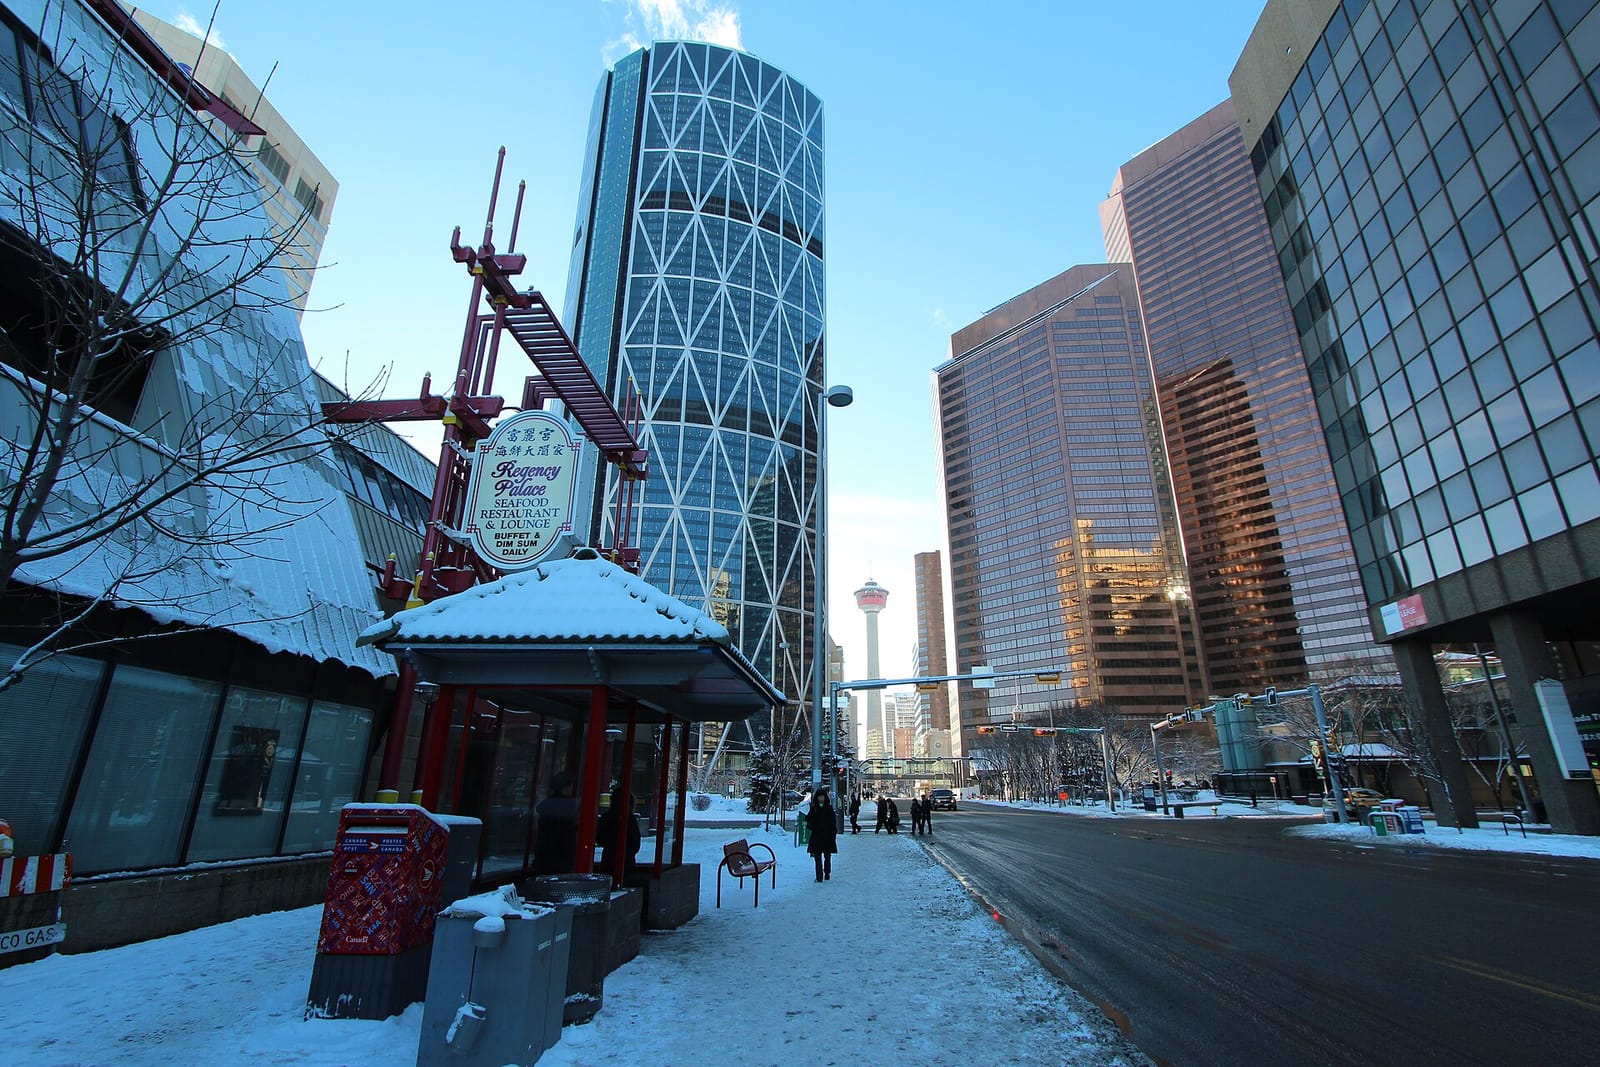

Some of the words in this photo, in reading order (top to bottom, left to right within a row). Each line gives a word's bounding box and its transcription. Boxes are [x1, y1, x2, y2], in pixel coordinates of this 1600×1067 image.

[491, 460, 562, 482] Regency
[494, 478, 547, 497] Palace
[494, 498, 549, 508] SEAFOOD
[480, 508, 560, 519] RESTAURANT
[485, 520, 495, 529] &
[500, 519, 551, 530] LOUNGE
[494, 532, 531, 540] BUFFET
[517, 540, 538, 548] SUM
[502, 548, 529, 556] DAILY
[1400, 606, 1417, 618] LEASE
[360, 876, 377, 896] S4N
[0, 934, 20, 950] CO
[26, 927, 56, 945] GAS
